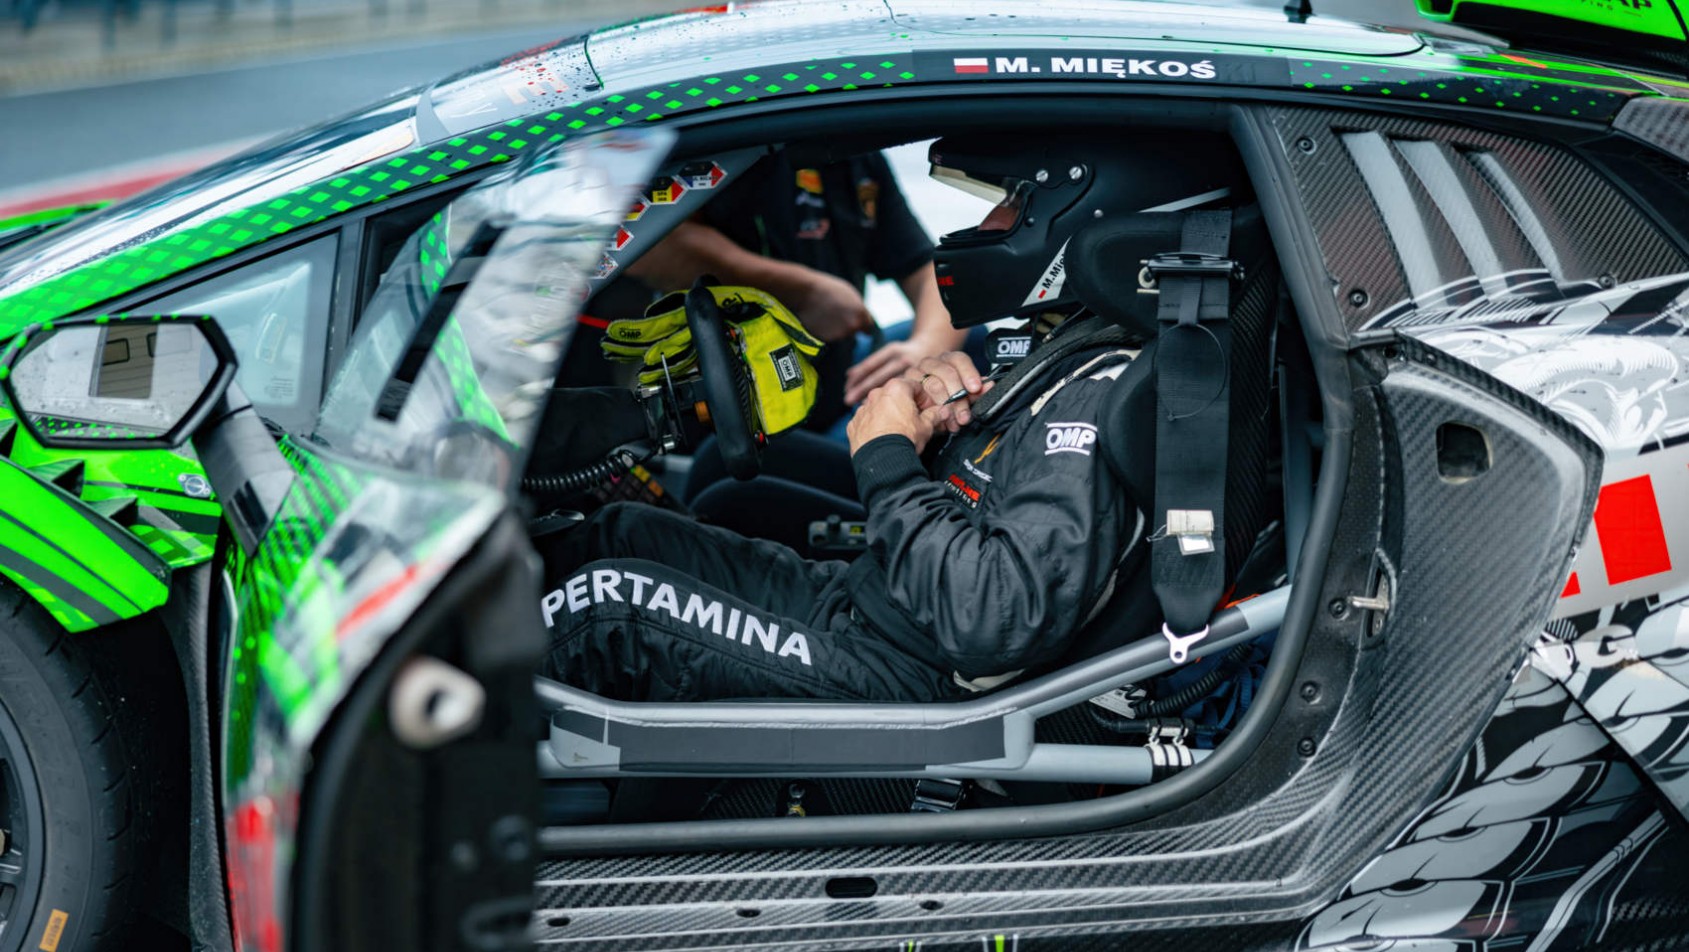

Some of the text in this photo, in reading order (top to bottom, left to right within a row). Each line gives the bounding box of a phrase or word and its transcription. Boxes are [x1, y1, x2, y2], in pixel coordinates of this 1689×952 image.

[995, 57, 1216, 79] M. MIĘKOŚ
[619, 329, 642, 339] OMP
[782, 359, 793, 377] OMP
[1046, 427, 1096, 450] OMP
[541, 569, 812, 666] PERTAMINA
